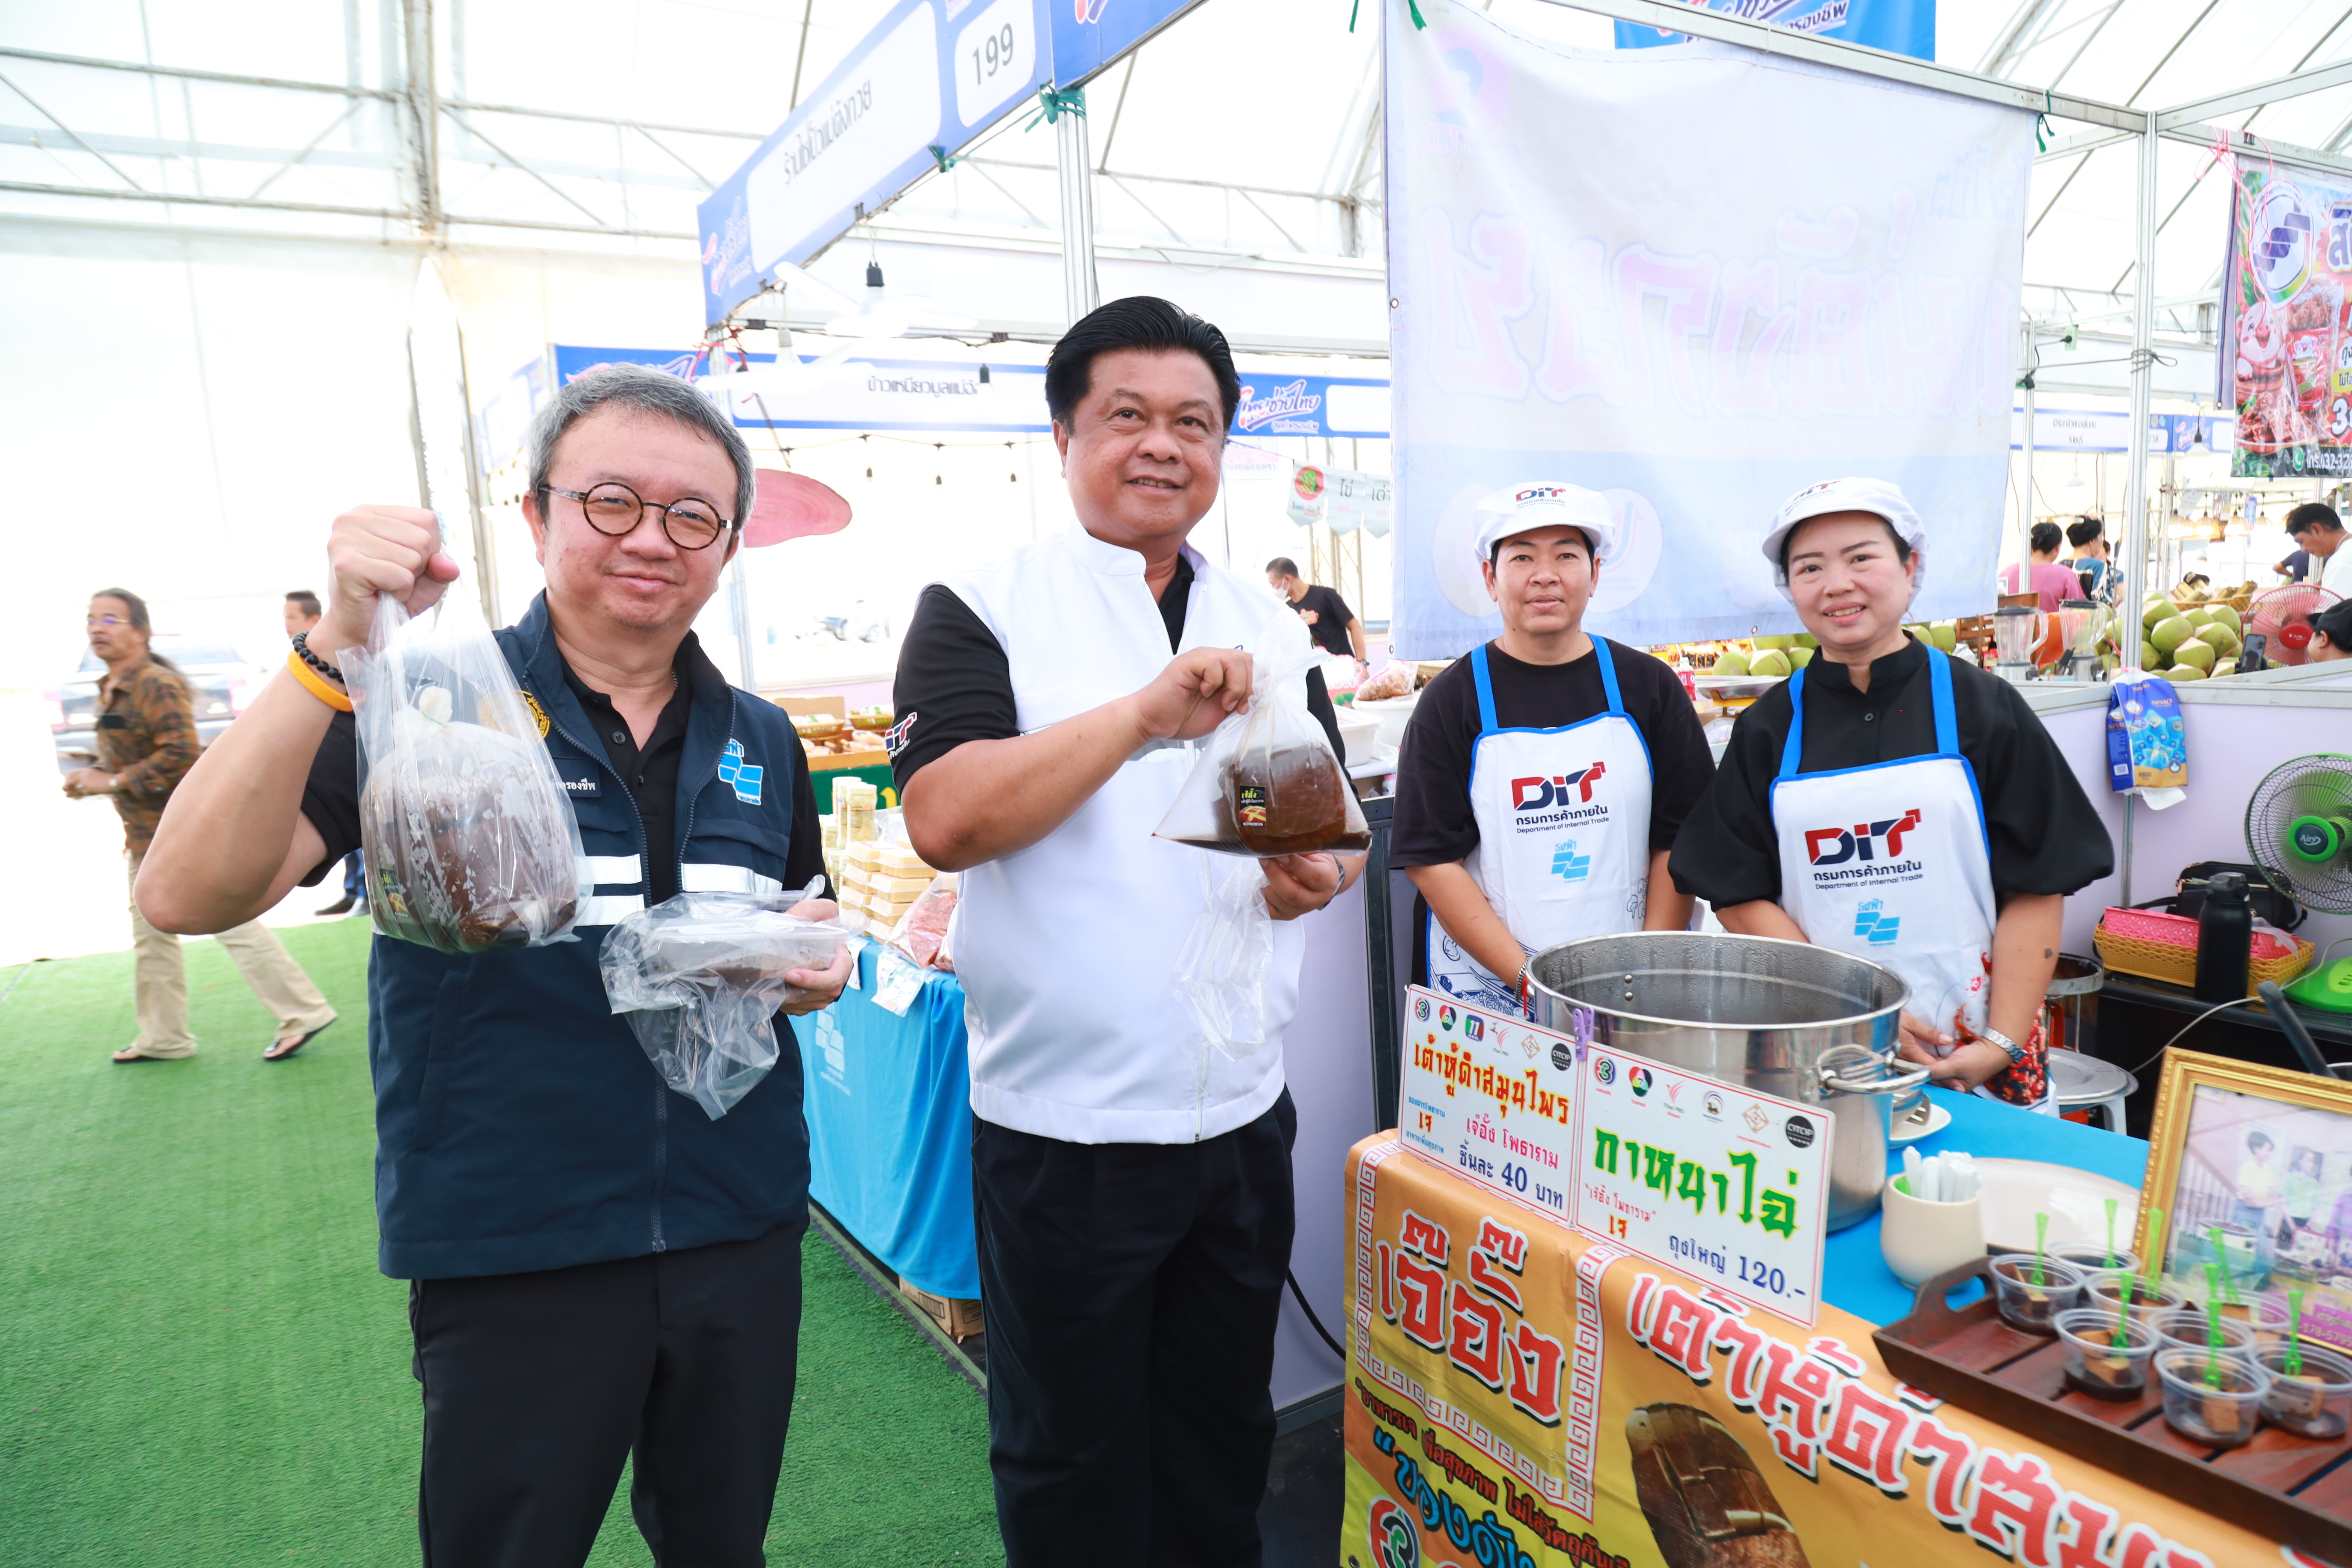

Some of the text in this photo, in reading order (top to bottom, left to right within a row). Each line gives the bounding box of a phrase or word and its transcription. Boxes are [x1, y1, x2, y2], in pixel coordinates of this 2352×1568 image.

[972, 23, 1014, 85] 199
[2332, 398, 2352, 436] 3
[1516, 805, 1608, 826] กรมการค้าภายใน
[1517, 824, 1556, 834] Department
[1565, 819, 1590, 829] Internal
[1591, 816, 1609, 825] Trade
[1556, 839, 1577, 852] ธงฟ้า
[2300, 835, 2321, 845] Airy
[1814, 861, 1922, 881] กรมการค้าภายใน
[1815, 881, 1859, 891] Department
[1869, 876, 1899, 886] Internal
[1900, 873, 1924, 883] Trade
[1858, 898, 1883, 911] ธงฟ้า
[1469, 1019, 1480, 1036] 11
[1553, 1049, 1571, 1061] OTOP
[1413, 1032, 1571, 1125] เต้าหู้ดำสมุนไพร
[1409, 1096, 1445, 1118] ของฝากโพธาราม
[1419, 1112, 1432, 1133] เจ
[1786, 1123, 1814, 1137] OTOP
[1503, 1129, 1559, 1170] โพธาราม
[1459, 1139, 1563, 1210] ชิ้นละ 40 บาท
[1609, 1214, 1628, 1239] เจ
[1670, 1235, 1806, 1298] ถุงใหญ่ 120.-
